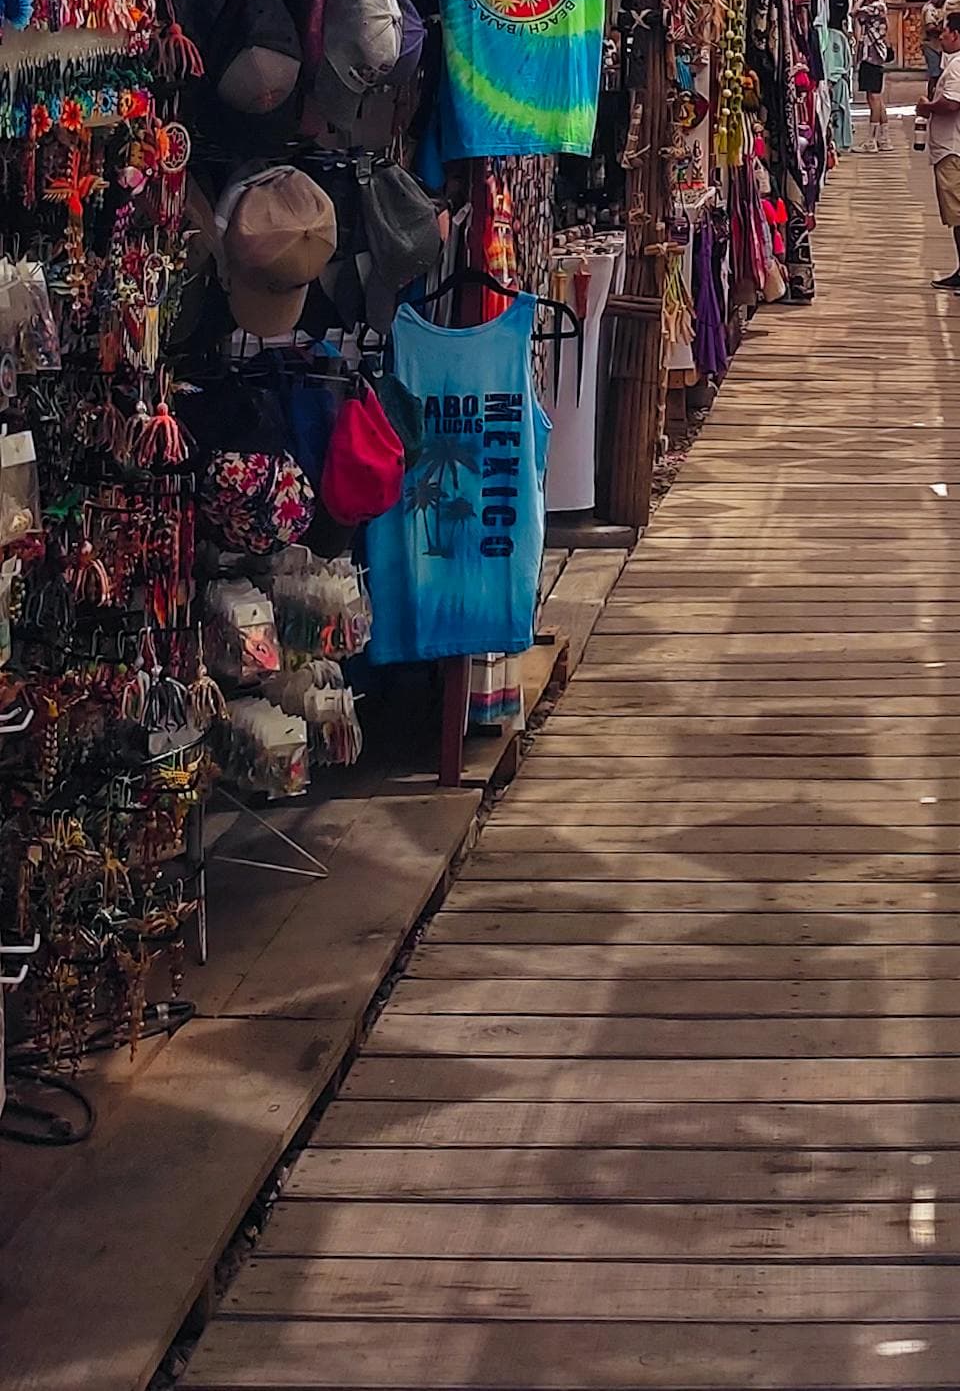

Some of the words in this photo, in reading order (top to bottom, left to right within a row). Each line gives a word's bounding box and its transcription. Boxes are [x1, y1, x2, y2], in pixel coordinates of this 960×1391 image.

[480, 12, 516, 35] BAJA
[529, 0, 576, 35] BEACH
[424, 394, 479, 418] ABO
[434, 418, 484, 434] LUCAS
[480, 393, 523, 558] MEXICO
